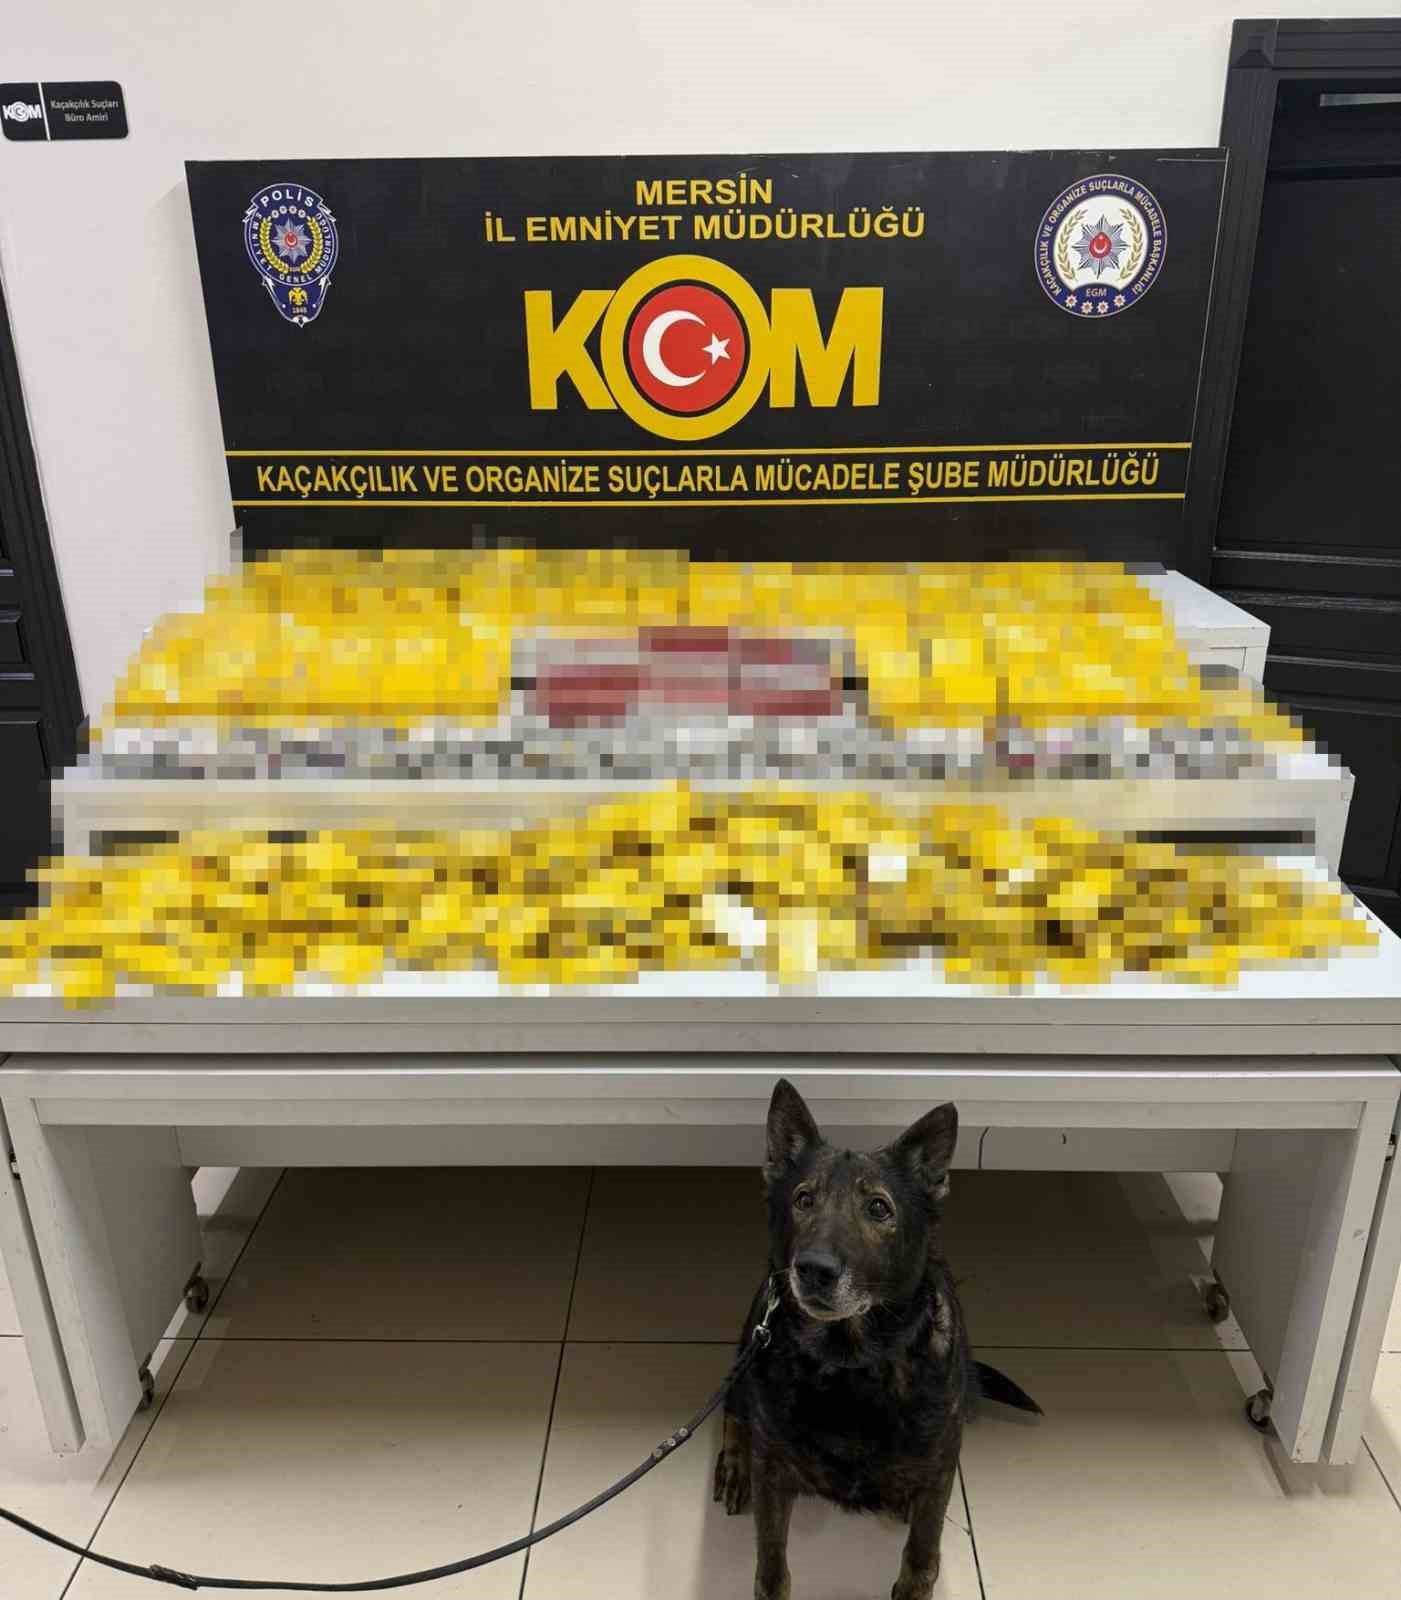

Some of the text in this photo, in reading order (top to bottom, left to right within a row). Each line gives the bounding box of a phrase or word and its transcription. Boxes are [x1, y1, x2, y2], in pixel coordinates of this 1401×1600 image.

[2, 101, 42, 122] KOM
[260, 188, 314, 207] POLİS
[635, 174, 773, 206] MERSİN
[485, 206, 926, 242] İL EMNİYET MÜDÜRLÜĞÜ
[1085, 287, 1107, 297] EGM
[524, 254, 884, 441] KOM
[256, 452, 1160, 499] KAÇAKÇILIK VE ORGANİZE SUÇLARLA MÜCADELE ŞUBE MÜDÜRLÜĞÜ
